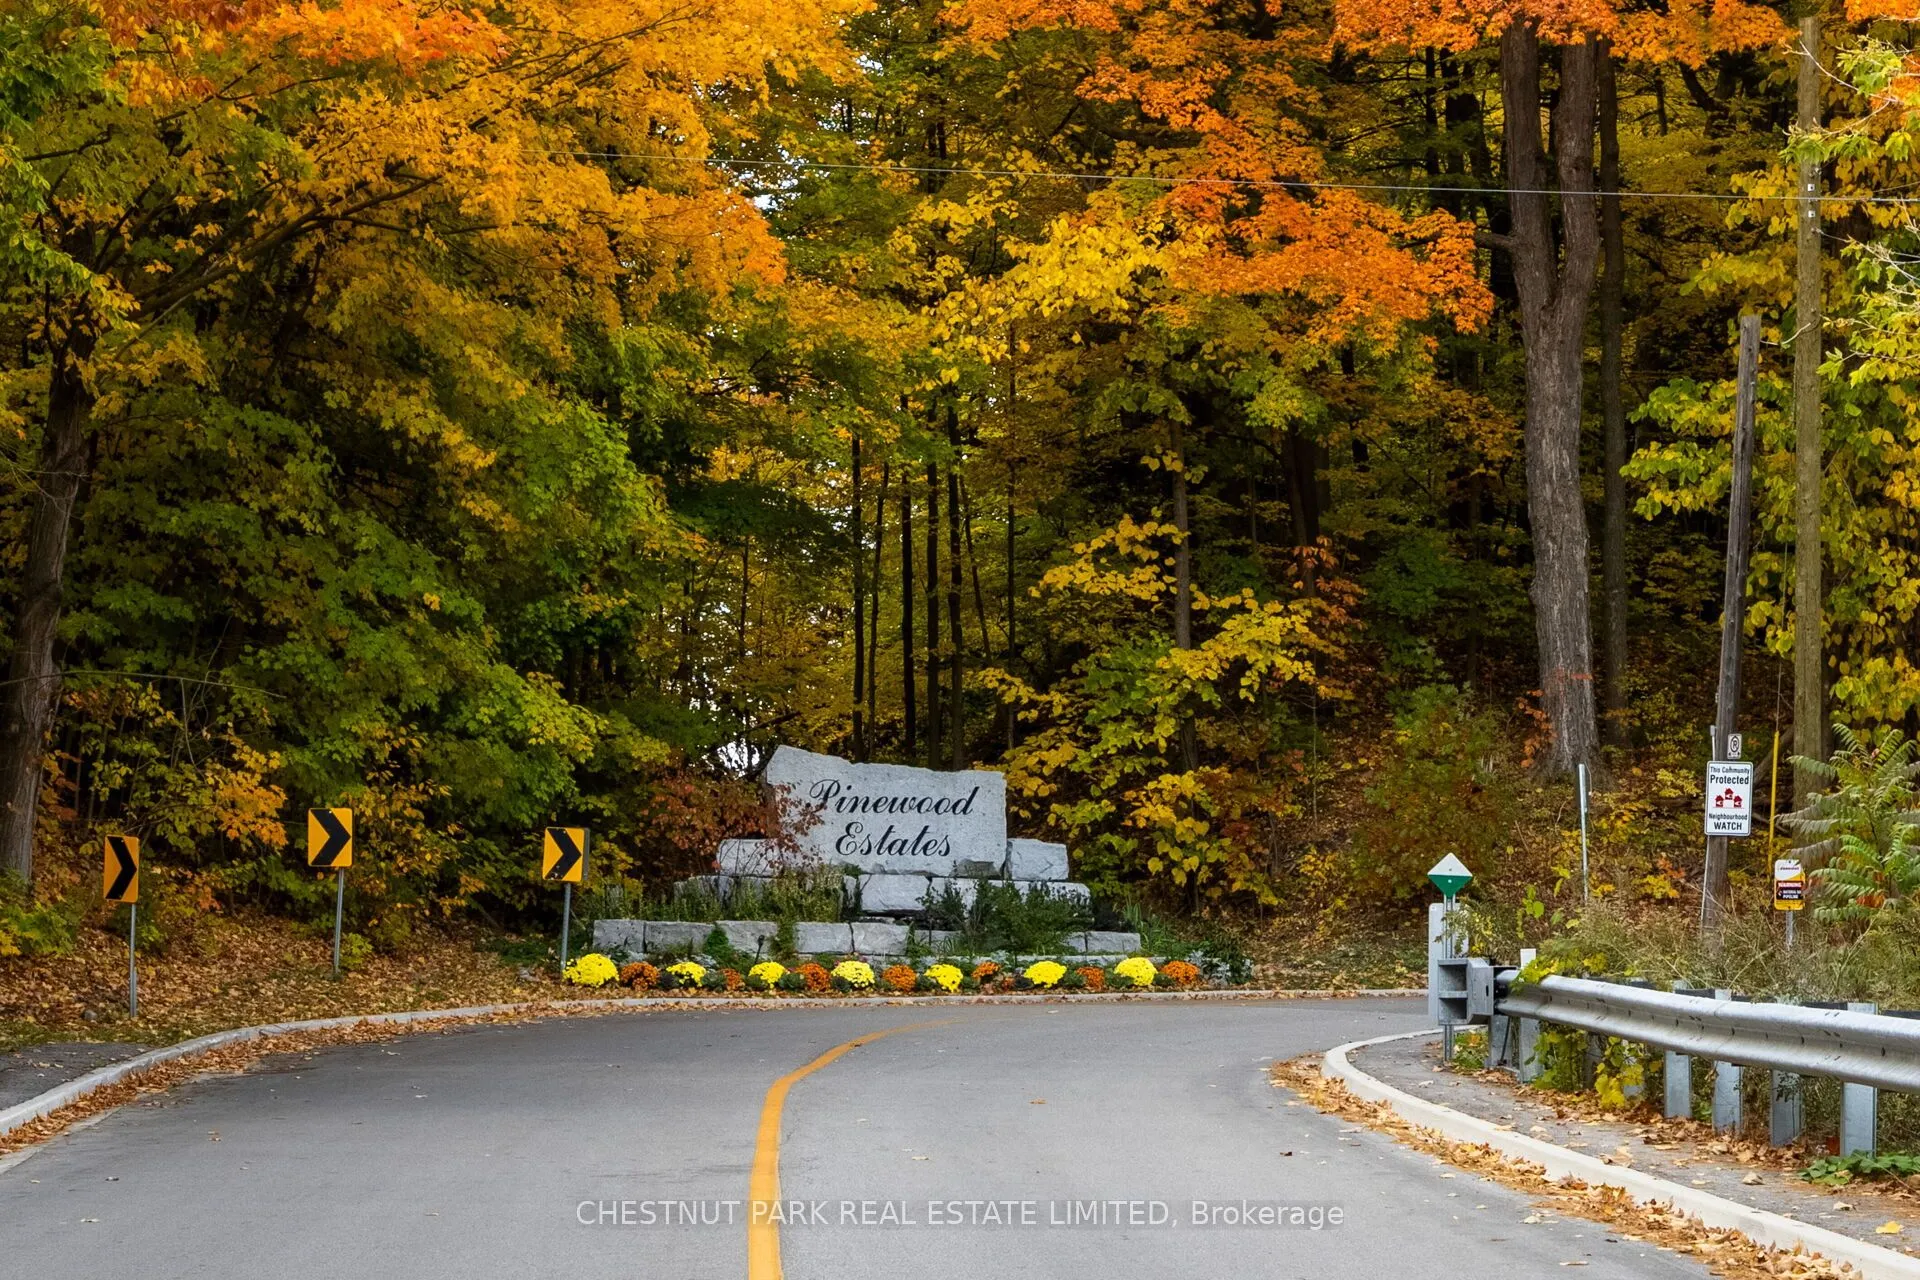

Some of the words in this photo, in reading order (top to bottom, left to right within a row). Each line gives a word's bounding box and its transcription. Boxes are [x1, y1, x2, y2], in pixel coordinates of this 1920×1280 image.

[1710, 775, 1749, 785] Protected
[809, 778, 980, 816] Pinewood
[1708, 812, 1748, 820] Neighbourhood
[1714, 821, 1742, 830] WATCH
[835, 822, 951, 857] Estates
